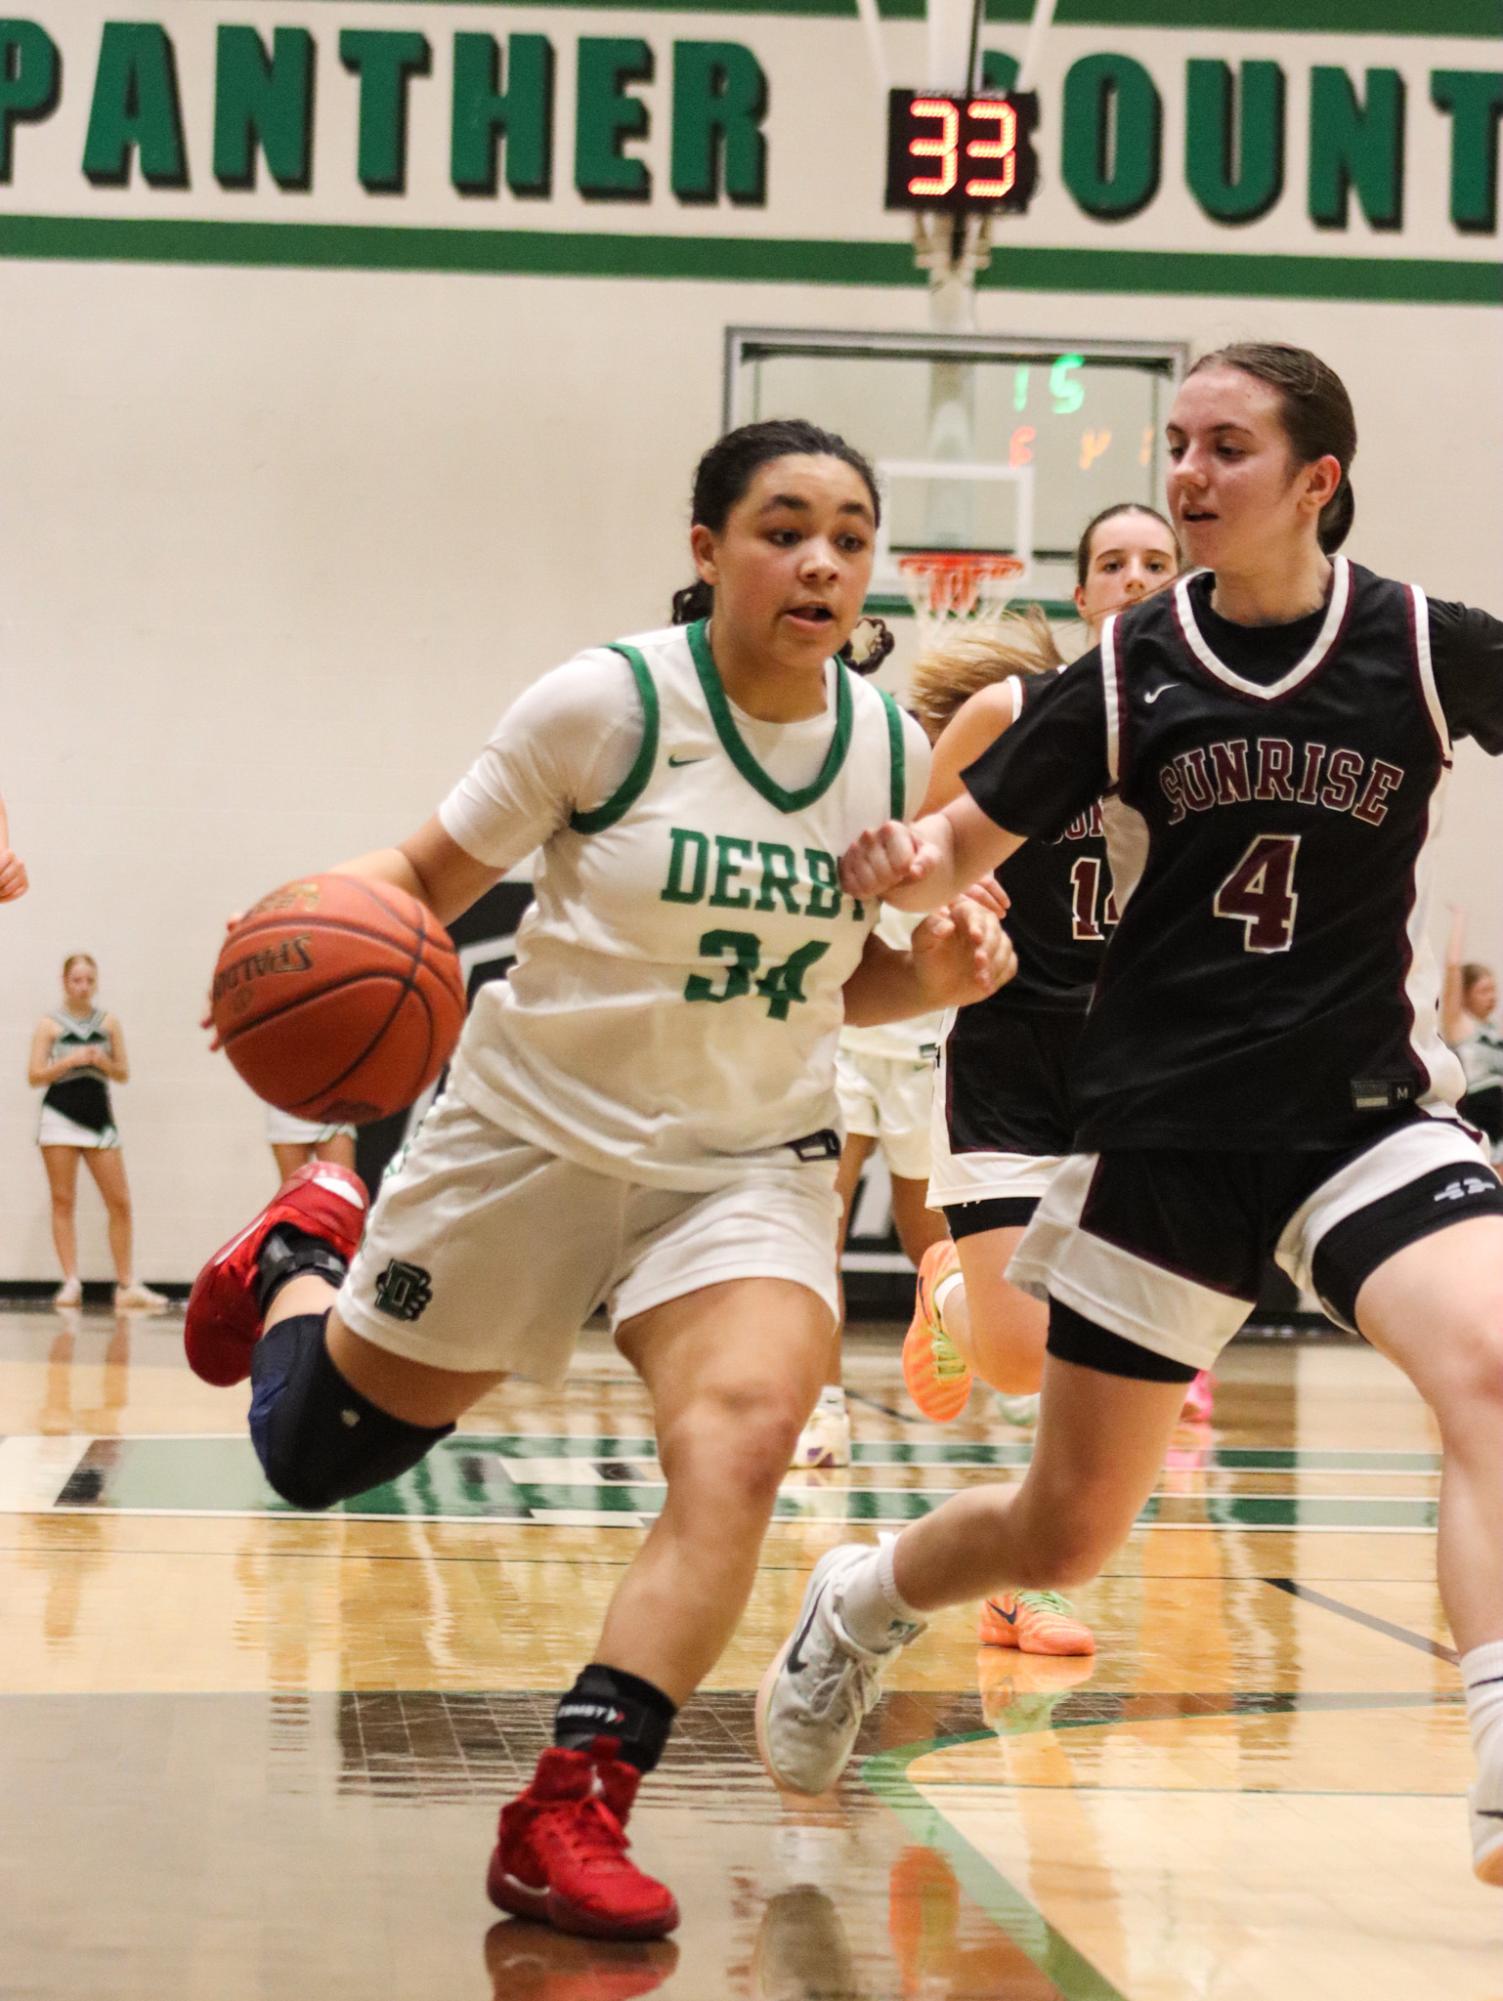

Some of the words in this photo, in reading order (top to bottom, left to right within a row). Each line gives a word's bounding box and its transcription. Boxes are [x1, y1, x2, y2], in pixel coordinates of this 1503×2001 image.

[0, 18, 769, 208] PANTHER
[982, 49, 1503, 234] OUNT
[908, 98, 1018, 197] 33
[1160, 737, 1405, 827] SUNRISE
[1213, 834, 1301, 954] 4
[684, 928, 832, 1021] 34
